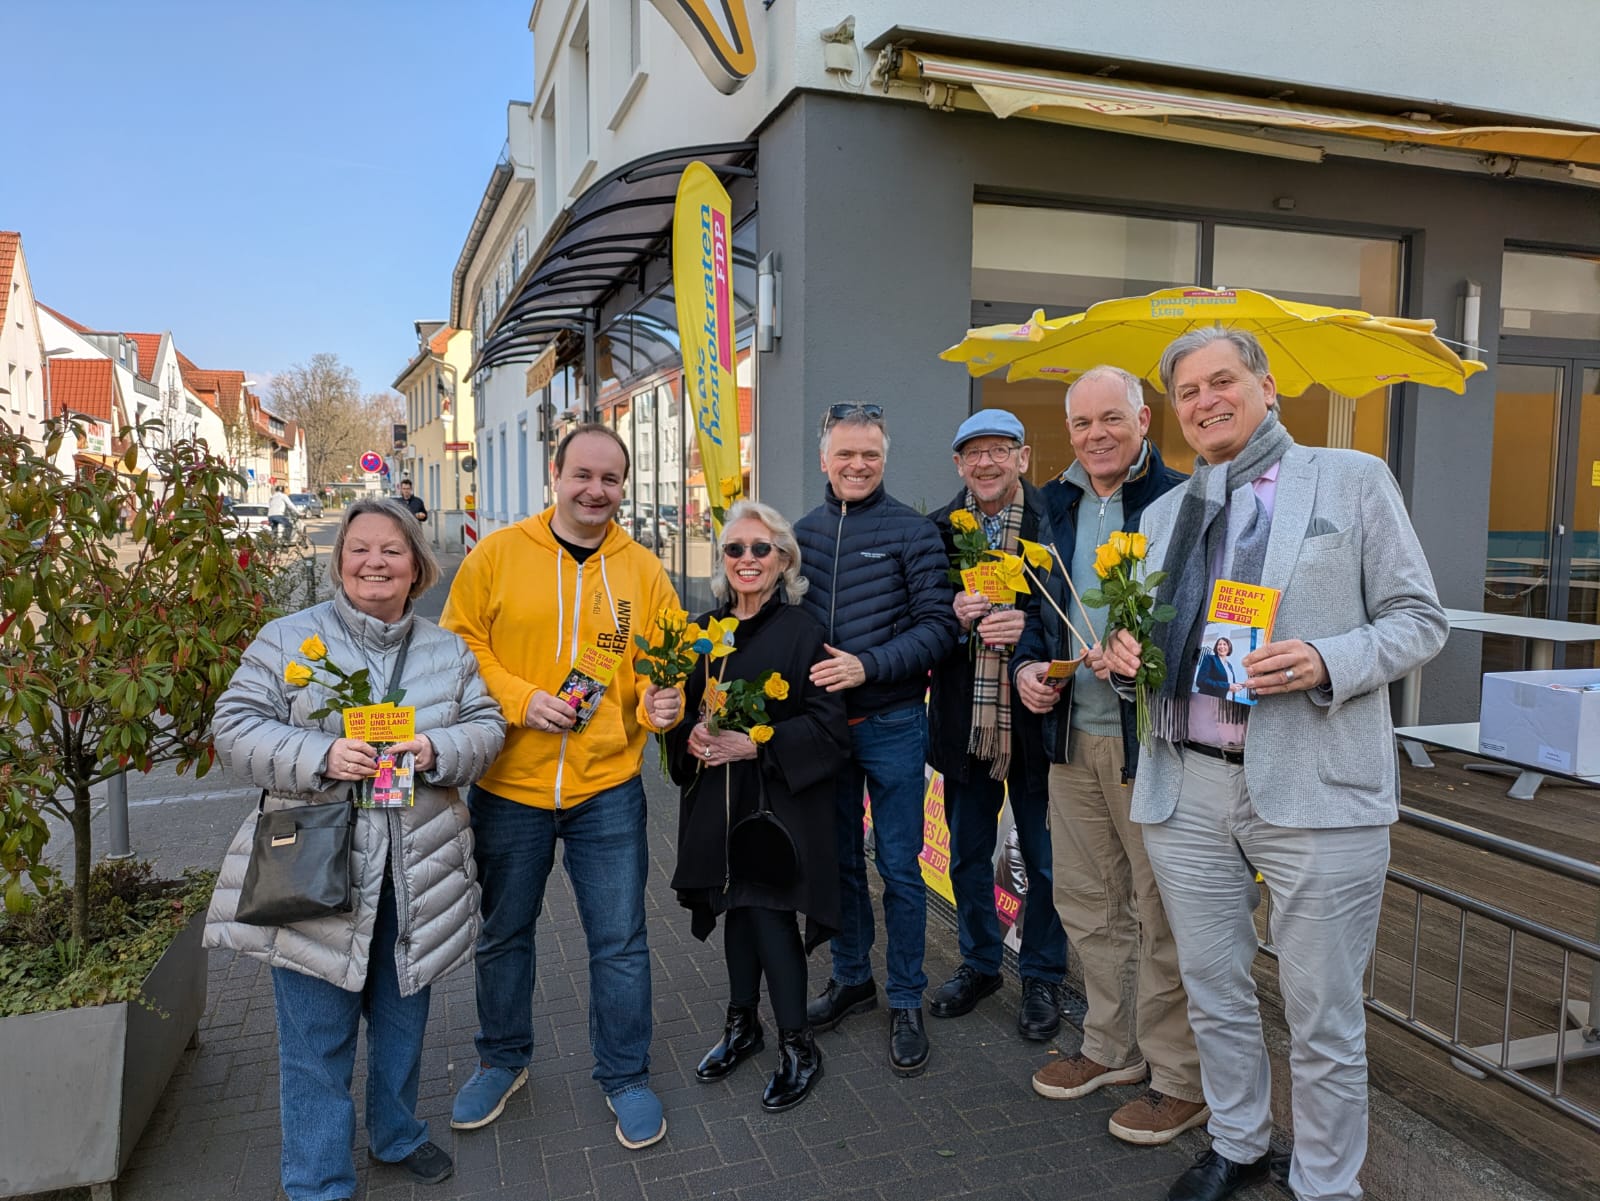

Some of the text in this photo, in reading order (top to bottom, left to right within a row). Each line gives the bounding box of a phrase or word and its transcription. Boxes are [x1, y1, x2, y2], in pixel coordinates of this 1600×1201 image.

[714, 221, 726, 285] FDP
[700, 203, 722, 447] Demokraten
[1218, 594, 1245, 605] DIE ES
[1220, 586, 1266, 602] DIE KRAFT,
[1217, 602, 1259, 616] BRAUCHT.
[1234, 614, 1251, 623] FDP
[596, 632, 613, 653] ER
[370, 719, 386, 727] UND
[386, 711, 410, 719] STADT
[930, 850, 948, 871] FDP
[997, 891, 1018, 914] FDP
